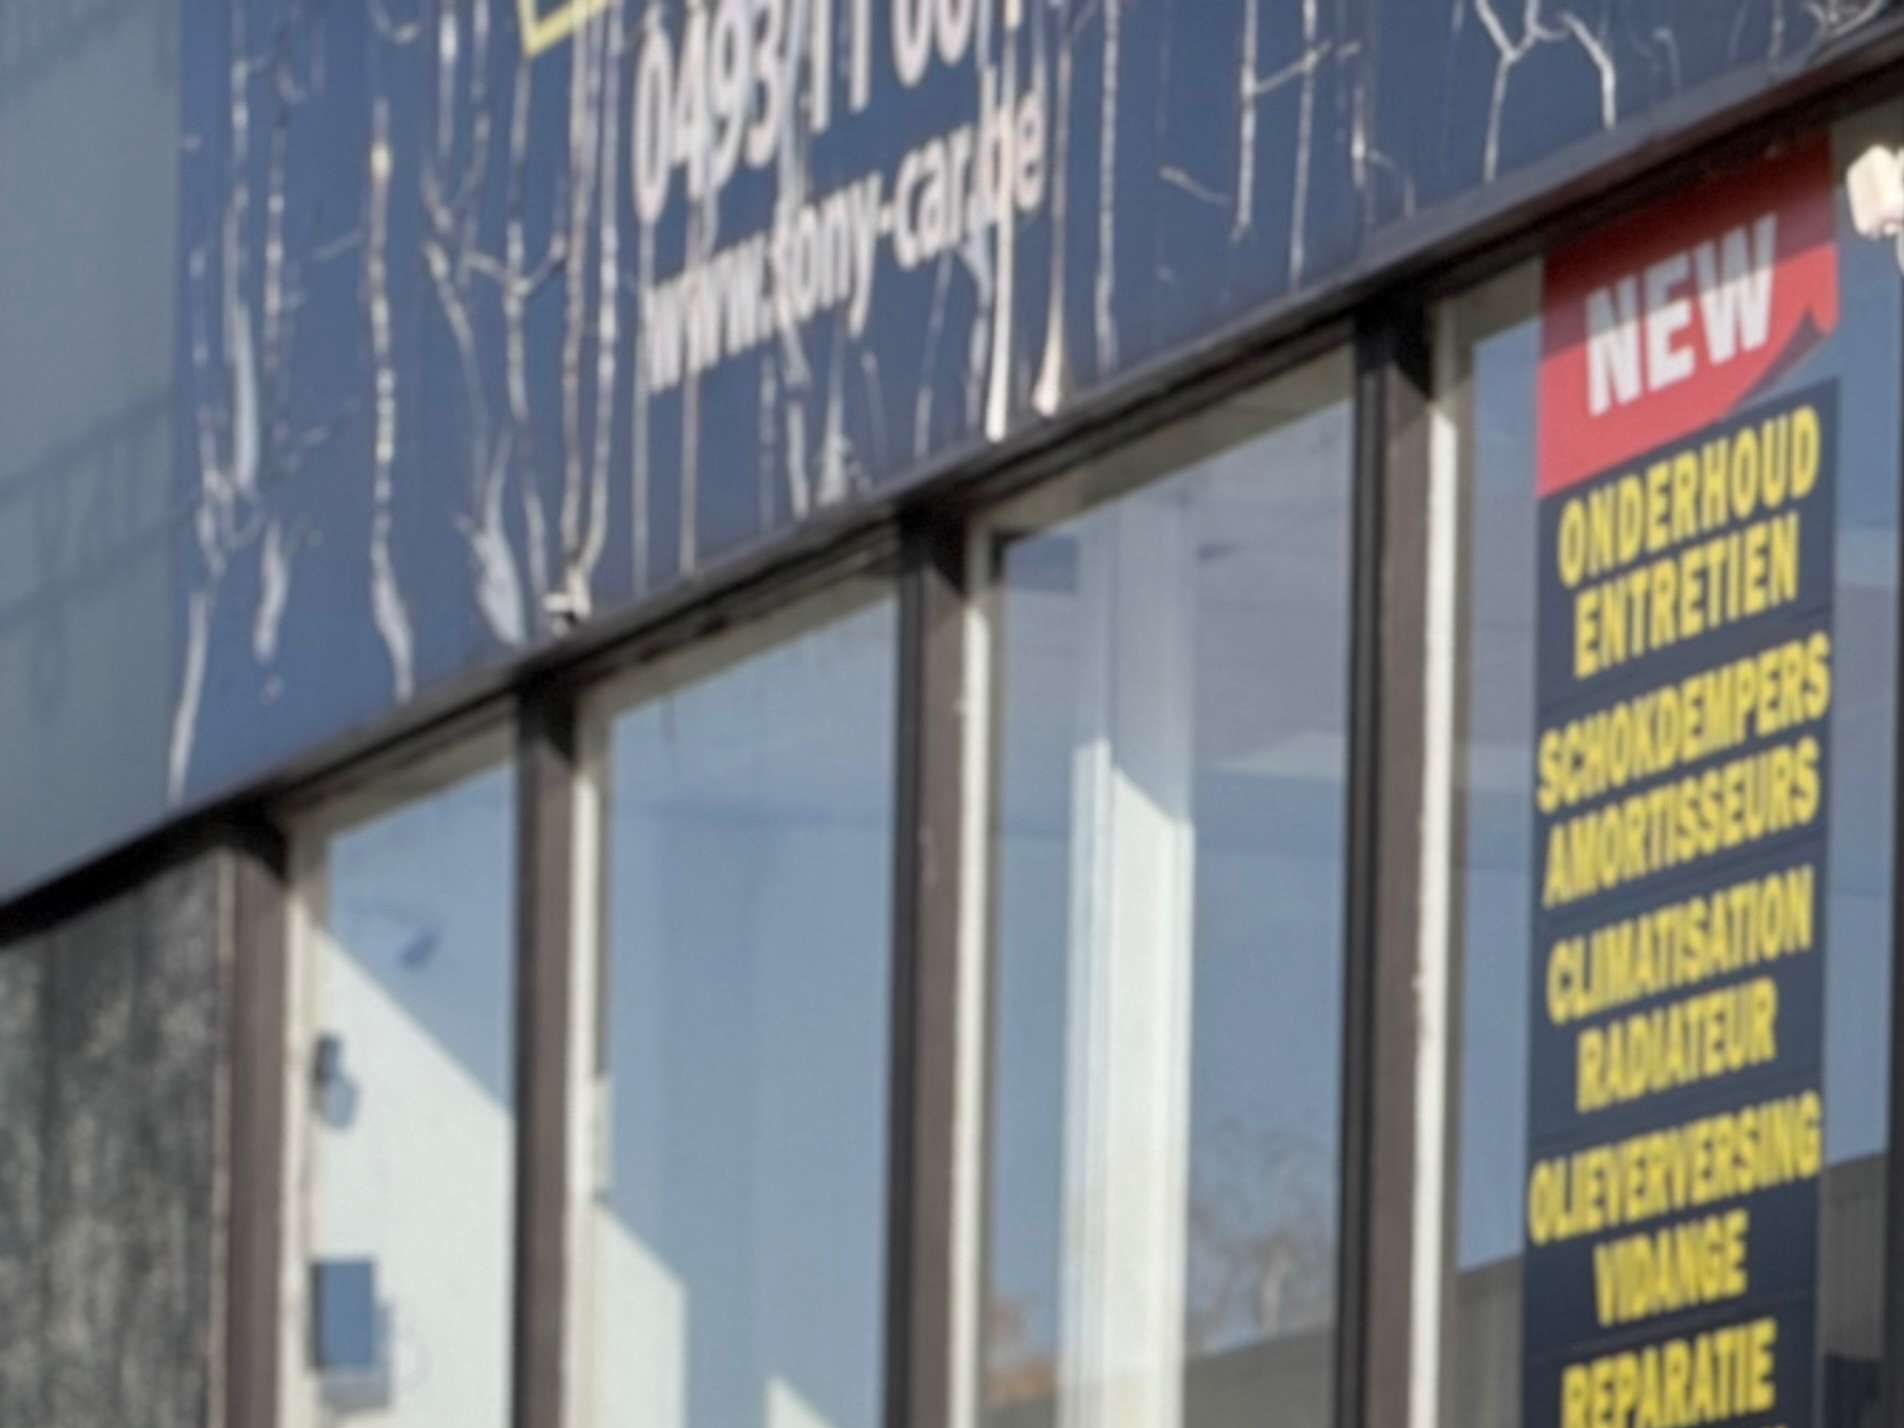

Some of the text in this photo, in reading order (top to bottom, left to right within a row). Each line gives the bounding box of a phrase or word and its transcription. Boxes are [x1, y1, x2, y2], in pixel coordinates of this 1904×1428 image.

[1585, 211, 1778, 418] NEW
[1557, 405, 1820, 588] ONDERHOUD
[1574, 510, 1799, 680] ENTRETIEN
[1537, 630, 1832, 814] SCHOKDEMPERS
[1541, 735, 1820, 908] AMORTISSEURS
[1546, 862, 1814, 1025] CLIMATISATION
[1575, 975, 1778, 1114] RADIATEUR
[1527, 1090, 1824, 1247] OLIEVERVERSING
[1594, 1207, 1750, 1328] VIDANGE
